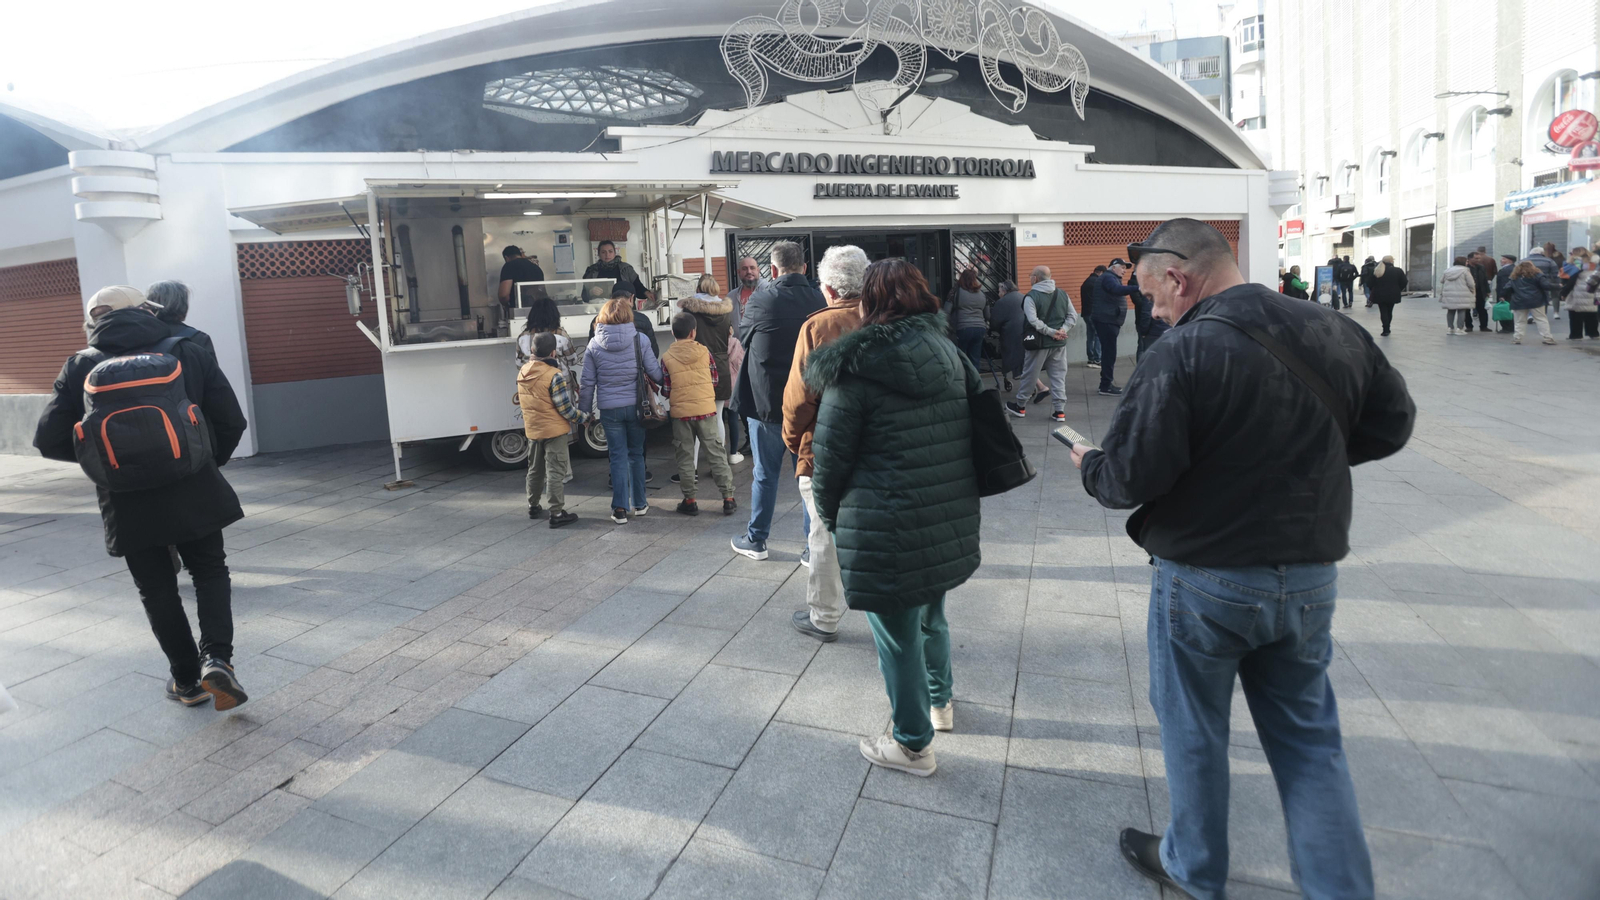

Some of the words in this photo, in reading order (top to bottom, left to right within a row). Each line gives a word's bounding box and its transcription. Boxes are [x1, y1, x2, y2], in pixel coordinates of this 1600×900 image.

[711, 150, 834, 173] MERCADO
[837, 154, 951, 175] INGENIERO
[952, 157, 1036, 177] TORROJA
[814, 183, 874, 197] PUERTA
[876, 183, 896, 198] DE
[898, 184, 960, 198] LEVANTE
